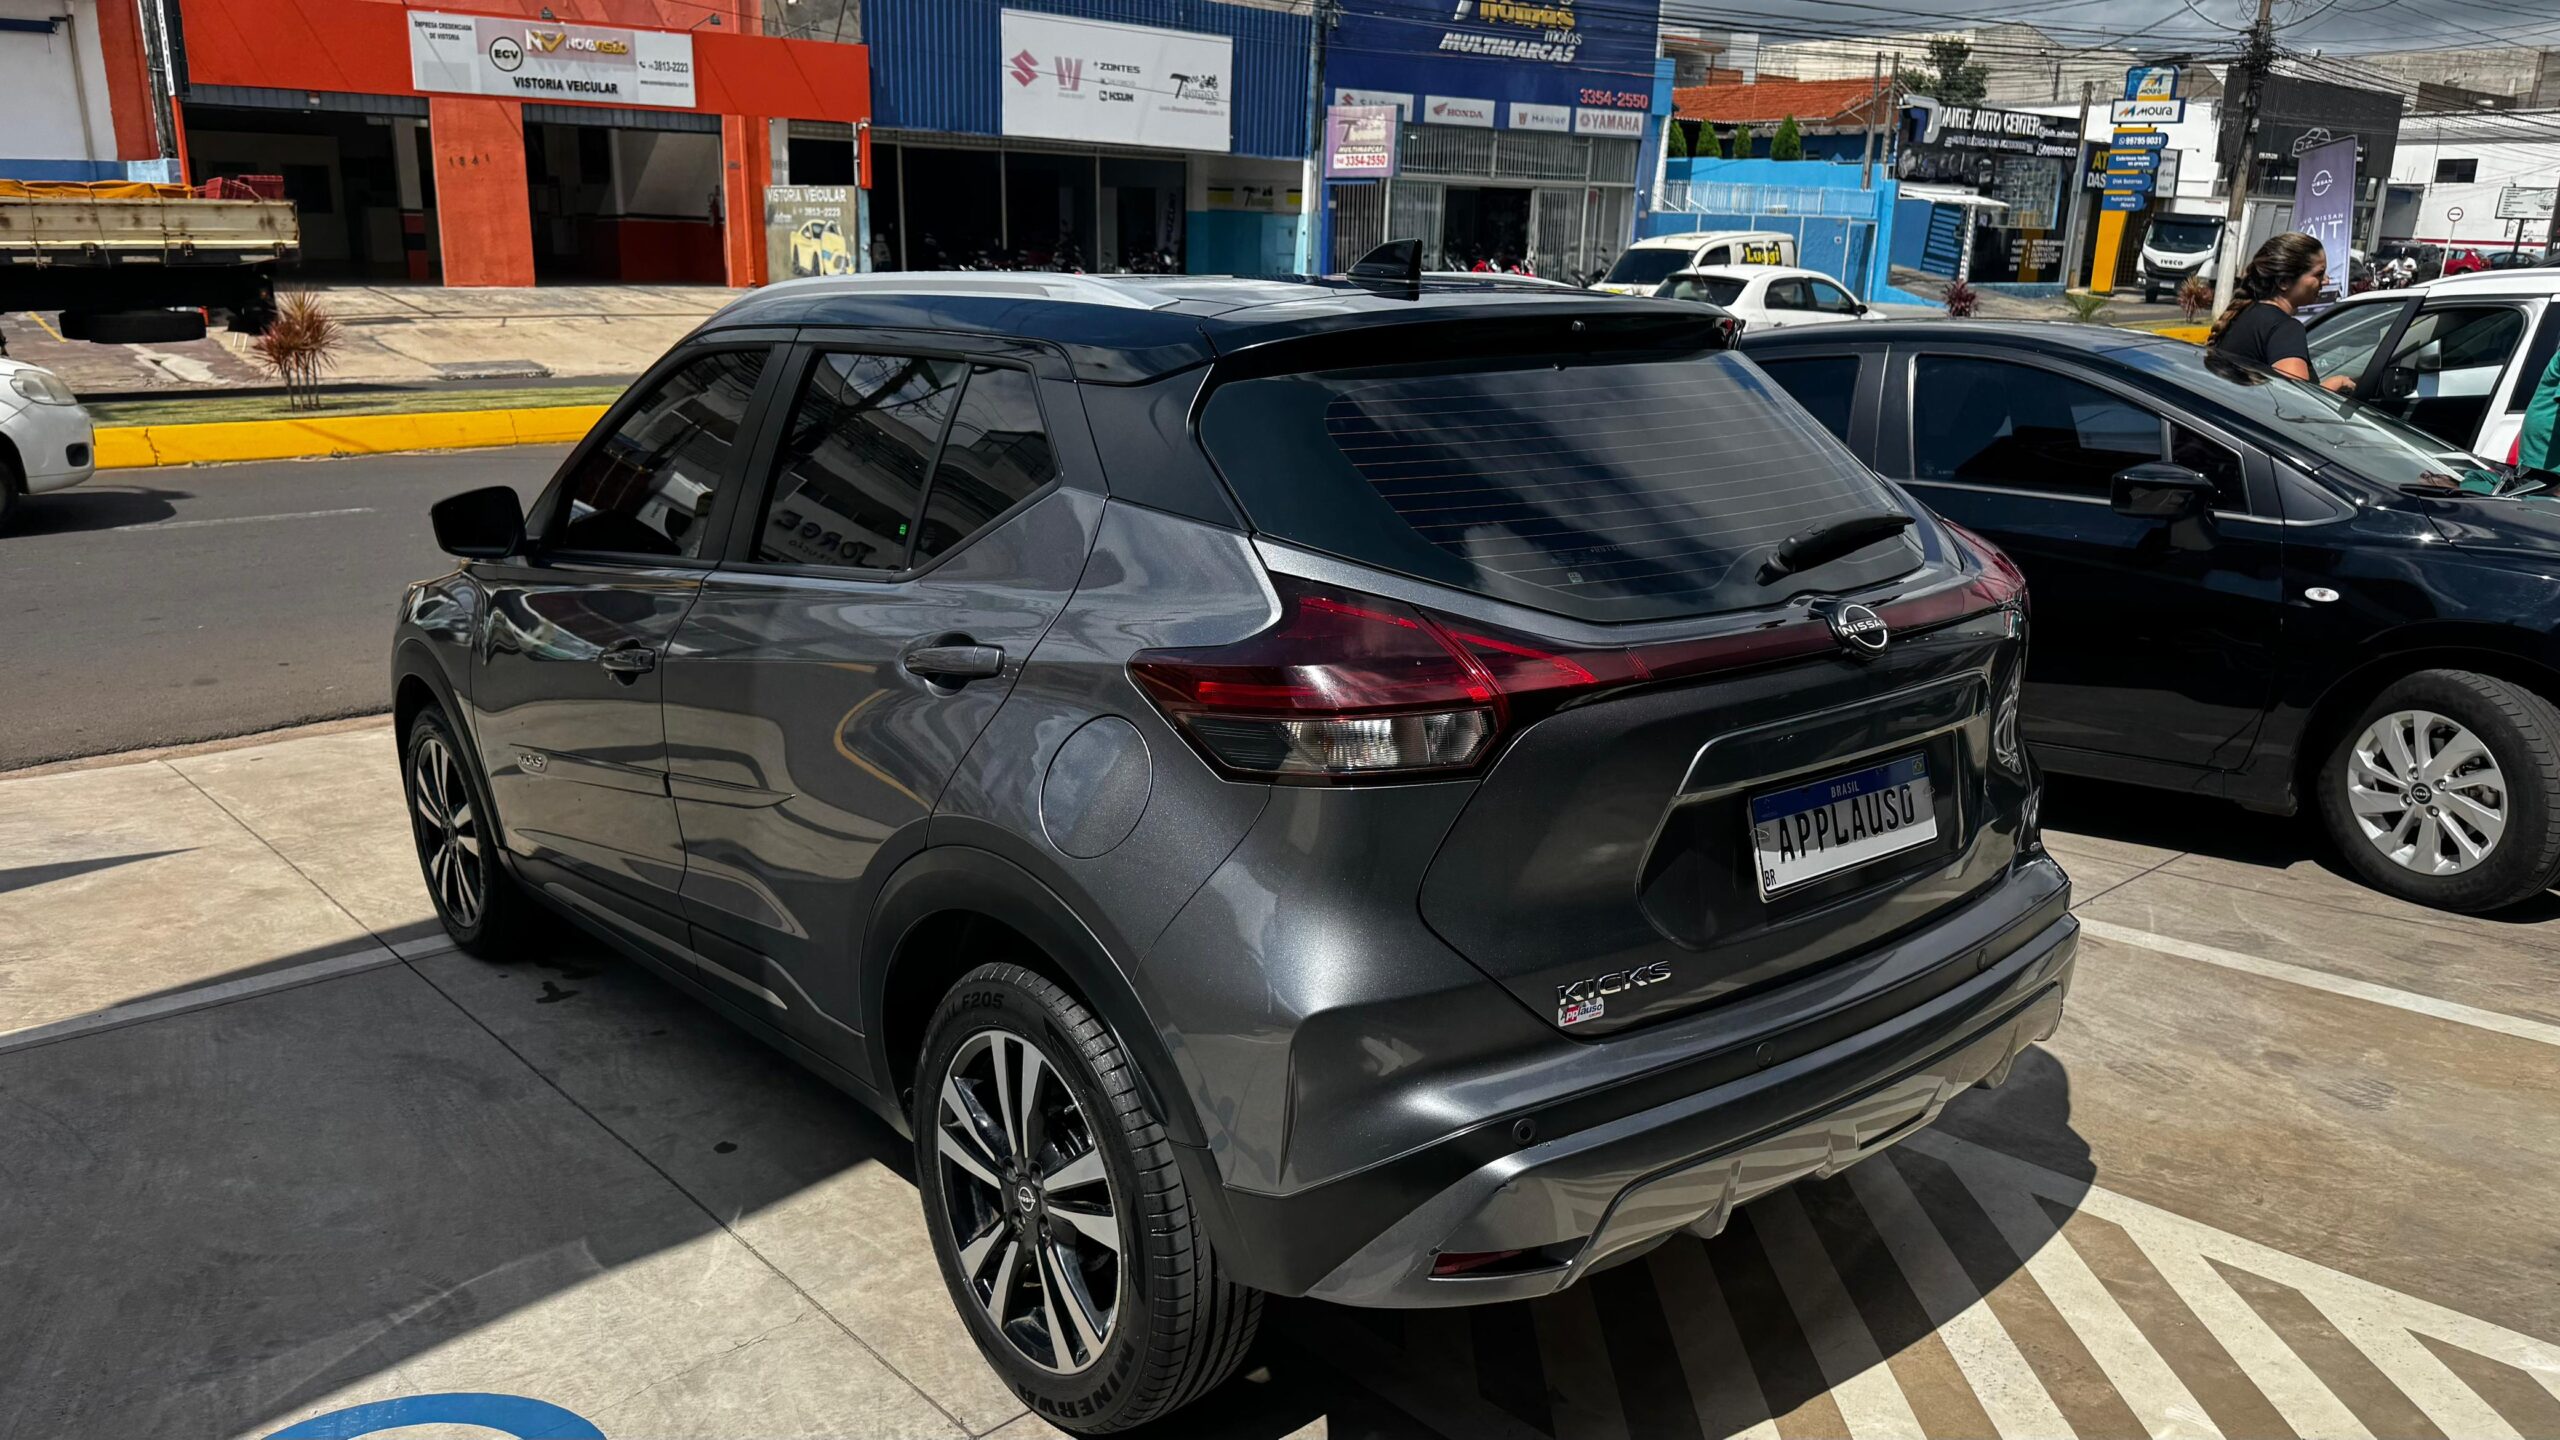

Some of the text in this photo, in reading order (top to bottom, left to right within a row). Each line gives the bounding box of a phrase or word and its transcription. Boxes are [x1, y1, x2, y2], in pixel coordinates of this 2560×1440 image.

[1439, 32, 1577, 62] MULTIMARCAS
[1544, 30, 1582, 45] motos
[494, 49, 519, 59] ECV
[1100, 62, 1141, 74] ZONTES
[512, 76, 619, 94] VISTORIA VEICULAR
[1580, 88, 1649, 109] 3354-2550
[1447, 109, 1484, 119] HONDA
[1592, 113, 1640, 132] YAMAHA
[1939, 106, 2041, 137] DANTE AUTO CENTER
[1345, 155, 1386, 166] 3354-2550
[2315, 213, 2343, 222] NISSAN
[2300, 220, 2343, 240] AIT
[1841, 619, 1887, 635] NISSAN
[1830, 780, 1860, 799] BRASIL
[1778, 783, 1916, 865] APPLAUSO
[1764, 868, 1777, 888] BR
[1557, 960, 1672, 1006] KICKS
[961, 990, 1005, 1010] F205
[1017, 1338, 1136, 1419] MINERVA
